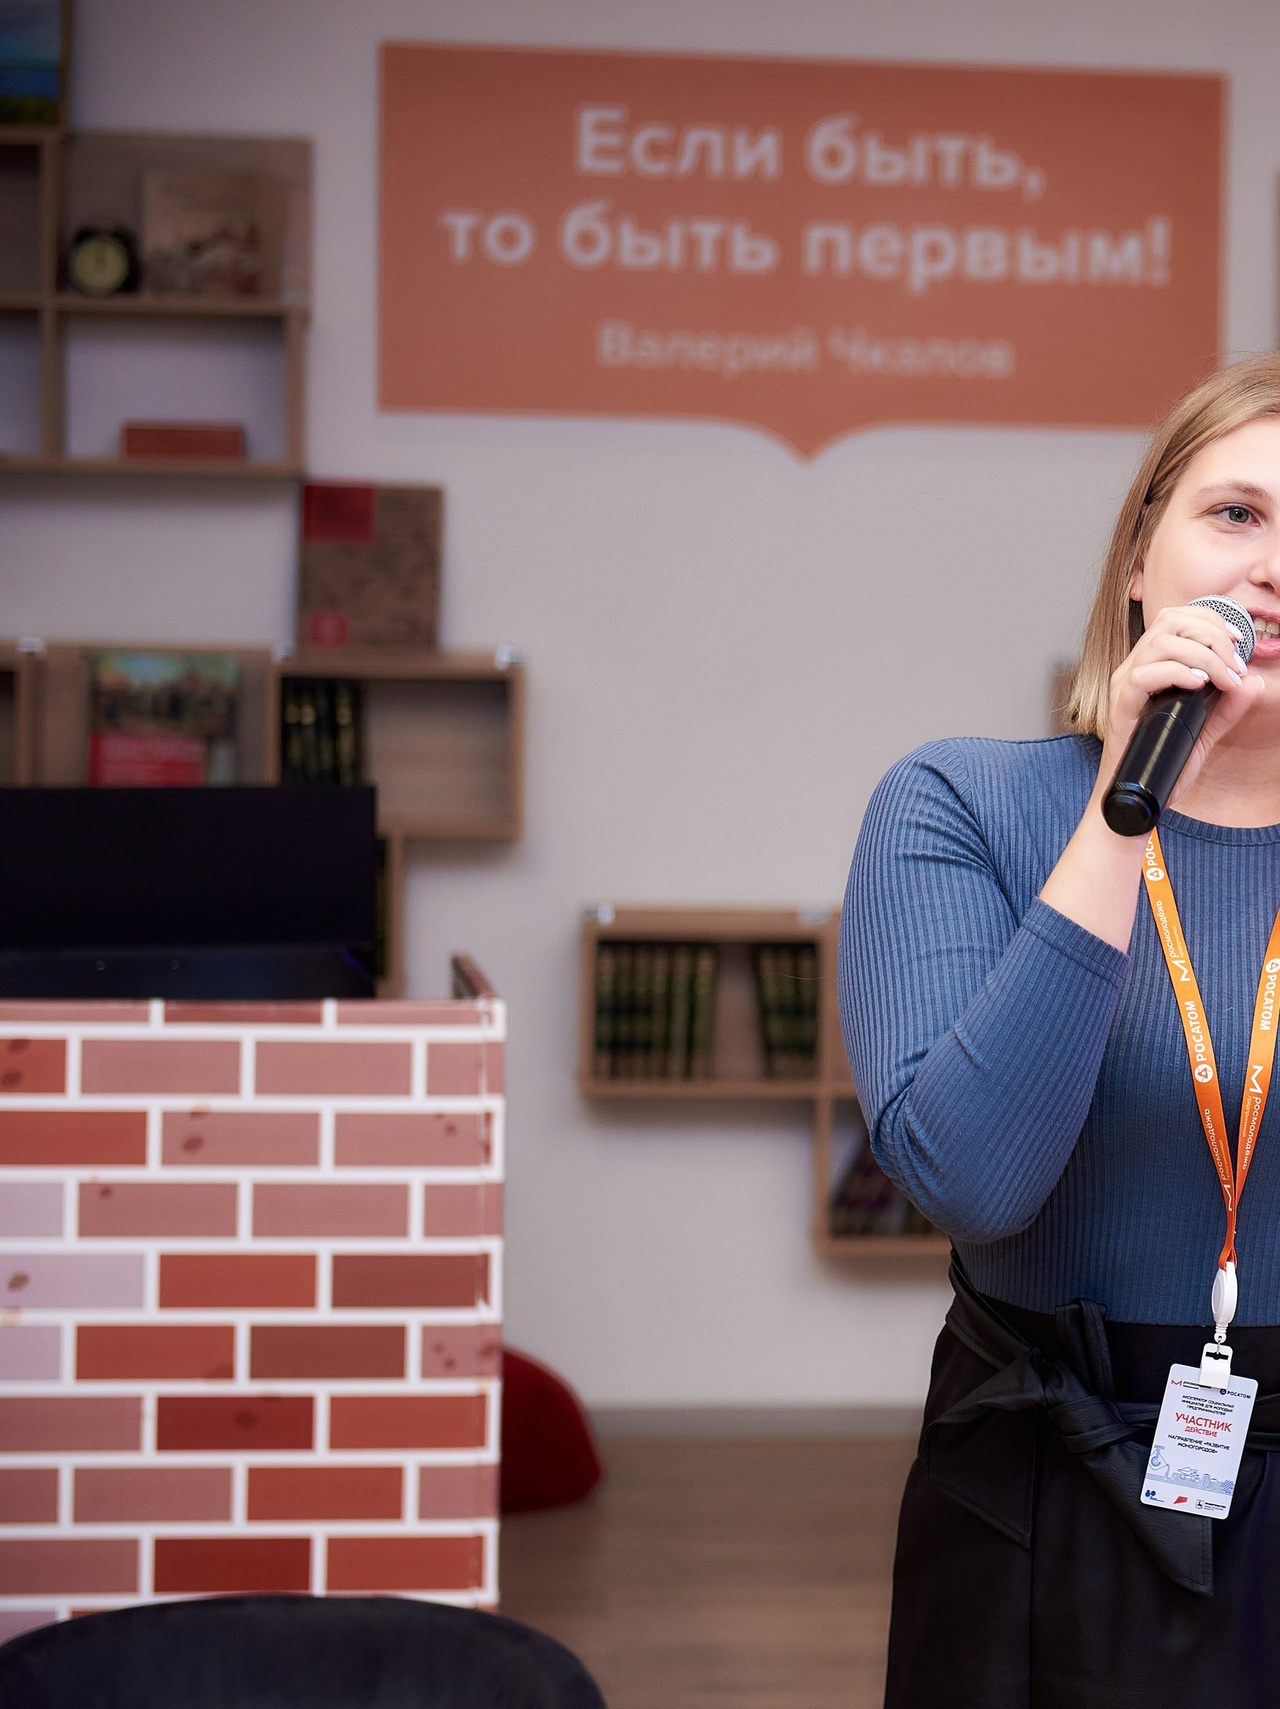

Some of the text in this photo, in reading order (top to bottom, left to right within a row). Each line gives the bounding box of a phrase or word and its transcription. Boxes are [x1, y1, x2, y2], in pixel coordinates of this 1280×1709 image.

[577, 105, 1045, 199] Если быть,
[441, 200, 1174, 294] то быть первым!
[598, 319, 1014, 380] Валерий Чкалов
[1184, 1001, 1207, 1062] РОСАТОМ
[1260, 974, 1277, 1031] РОСАТОМ
[1175, 1412, 1233, 1432] УЧАСТНИК
[1227, 1390, 1251, 1399] РОСАТОМ
[1185, 1425, 1218, 1437] ДЕЙСТВИЕ
